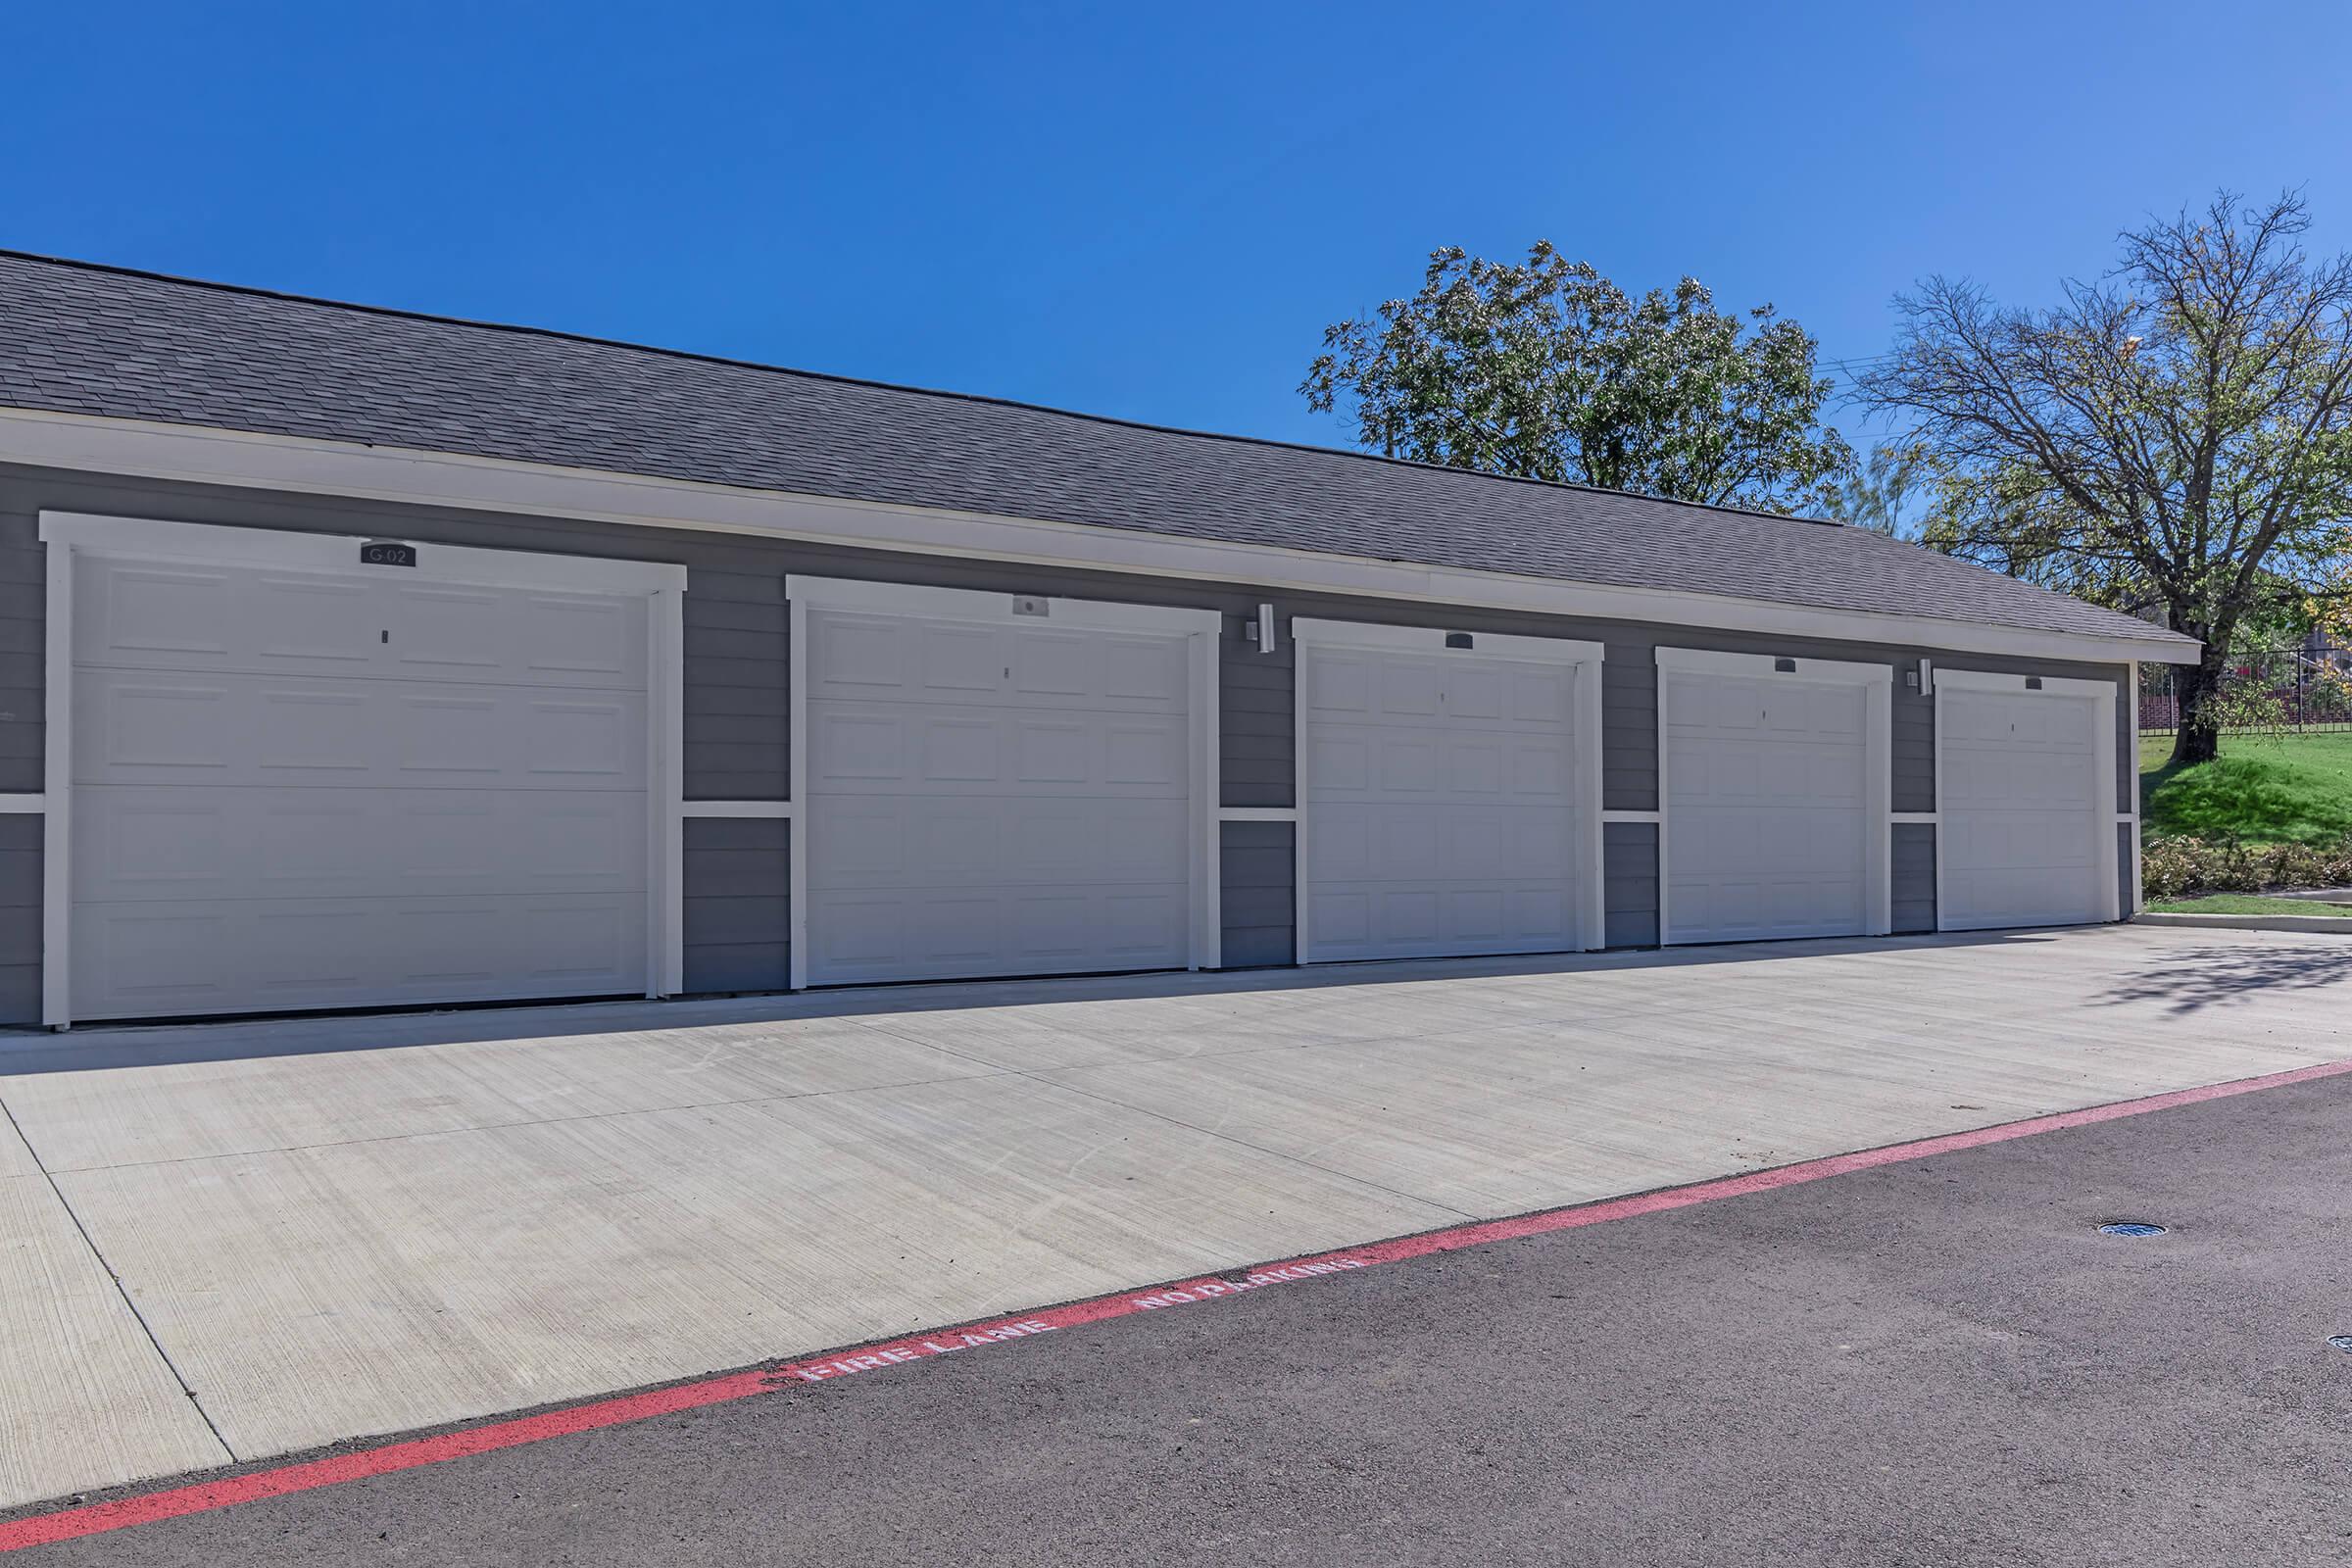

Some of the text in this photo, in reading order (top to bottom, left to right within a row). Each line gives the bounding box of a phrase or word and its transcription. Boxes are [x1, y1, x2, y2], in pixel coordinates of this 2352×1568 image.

[797, 1258, 1366, 1381] FIRE LANE NO PARKING
